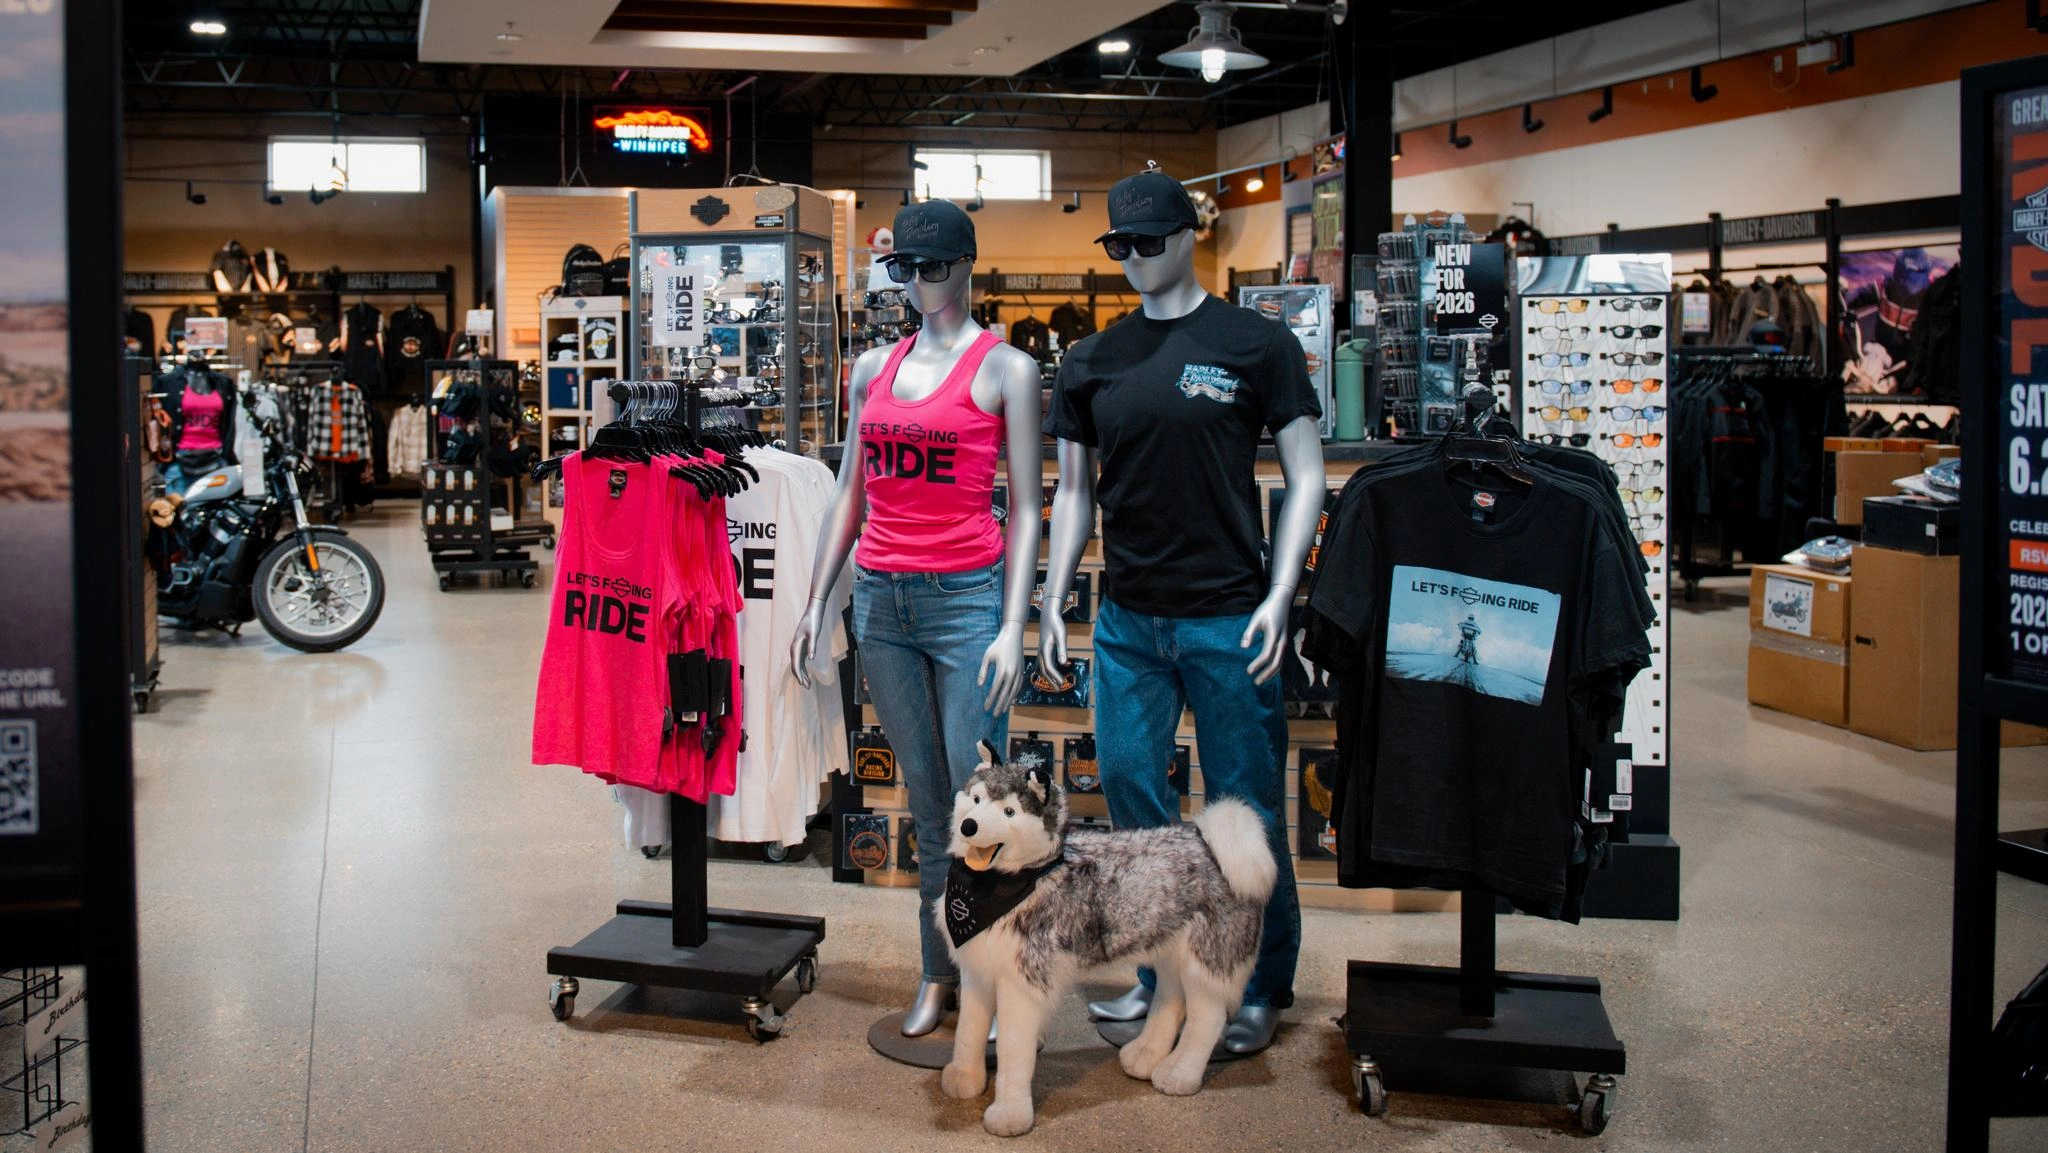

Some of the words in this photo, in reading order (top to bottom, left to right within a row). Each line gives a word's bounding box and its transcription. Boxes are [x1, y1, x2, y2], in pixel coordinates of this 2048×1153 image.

[1435, 244, 1471, 266] NEW
[1005, 274, 1083, 290] HARLEY-DAVIDSON
[1436, 268, 1465, 290] FOR
[675, 275, 694, 331] RIDE
[1436, 292, 1475, 315] 2026
[860, 422, 889, 436] ET'S
[862, 440, 957, 485] RIDE
[567, 571, 600, 588] LET'S
[1411, 580, 1449, 596] LET'S
[1508, 597, 1540, 614] RIDE
[564, 589, 650, 644] RIDE
[2010, 592, 2048, 629] 202
[23, 688, 67, 709] URL
